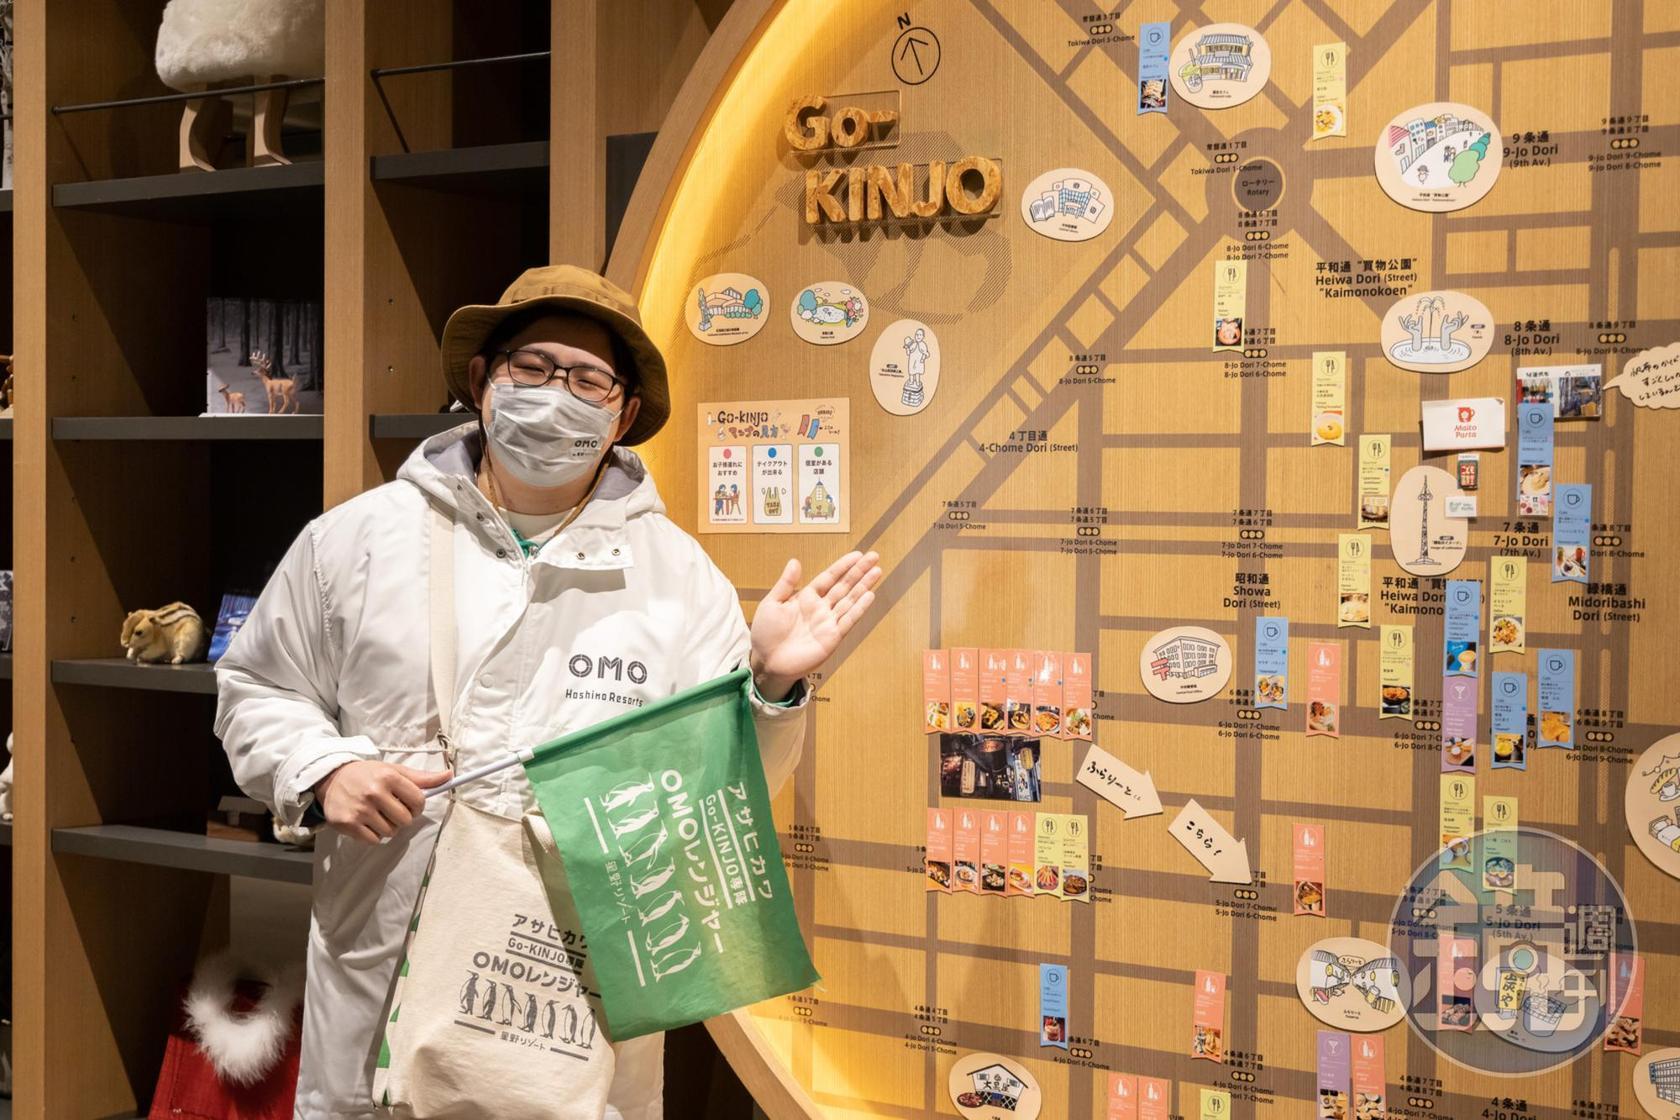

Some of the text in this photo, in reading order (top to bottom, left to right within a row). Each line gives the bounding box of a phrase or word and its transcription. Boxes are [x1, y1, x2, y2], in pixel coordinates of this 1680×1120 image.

[897, 12, 912, 30] N
[1068, 37, 1105, 47] Tokiwa Dori
[1502, 143, 1558, 158] 9-Jo Dori
[1509, 157, 1551, 168] (9th Av.)
[1588, 152, 1623, 163] 9-Jo Dori
[1233, 164, 1263, 172] 1-Chome
[1588, 162, 1623, 173] 9-Jo Dori
[1242, 179, 1275, 187] ロータリー
[805, 156, 1002, 224] KINJO
[1247, 188, 1269, 197] Rotary
[1226, 242, 1289, 252] 8-Jo Dori 6-Chome
[1226, 254, 1240, 262] 8-Jo
[1315, 261, 1351, 274] 平和通
[1315, 272, 1418, 286] Heiwa Dori (Street)
[1504, 333, 1560, 347] 8-Jo Dori
[1511, 346, 1552, 357] (8th Av.)
[1576, 347, 1592, 357] 8-Jo
[1594, 346, 1610, 355] Dori
[1224, 360, 1287, 370] 8-Jo Dori 7-Chome
[1224, 369, 1287, 379] 8-Jo Dori 6-Chome
[1058, 376, 1117, 386] 8-Jo Dori 5-Chome
[717, 410, 769, 427] Go-KINJO
[728, 424, 779, 440] マップの見方
[1009, 430, 1048, 442] 4丁目通
[574, 439, 598, 449] OMO
[979, 441, 1079, 453] 4-Chome Dori (Street)
[757, 460, 788, 468] テイクアウト
[717, 469, 738, 477] おすすめ
[762, 469, 783, 477] が出来る
[933, 522, 987, 530] 7-Jo Dori 5-Chome
[1503, 521, 1540, 534] 7条通
[1060, 538, 1118, 547] 7-Jo Dori 6-Chome
[1221, 541, 1283, 551] 7-Jo Dori 7-Chome
[1494, 535, 1549, 548] 7-Jo Dori
[1060, 547, 1118, 556] 7-Jo Dori 5-Chome
[1221, 551, 1283, 560] 7-Jo Dori 6-Chome
[1500, 548, 1541, 559] (7th Av.)
[1235, 572, 1270, 585] 昭和通
[1382, 576, 1419, 589] 平和通
[1233, 585, 1271, 597] Showa
[1586, 582, 1627, 596] 緑橋通
[1380, 590, 1418, 602] Heiwa
[1223, 597, 1281, 610] Dori (Street)
[1568, 595, 1646, 609] Midoribashi
[1384, 602, 1445, 615] "Kaimono
[1573, 609, 1640, 623] Dori (Street)
[568, 653, 648, 684] OMO
[565, 688, 644, 707] Hoshino Resorts
[1218, 721, 1280, 731] 6-Jo Dori 7-Chome
[1218, 730, 1280, 741] 6-Jo Dori 6-Chome
[1394, 731, 1426, 742] 6-Jo Dori
[1394, 741, 1426, 751] 6-Jo Dori
[1582, 744, 1598, 752] Dori
[1566, 753, 1598, 762] 6-Jo Dori
[727, 781, 774, 900] アサヒカワ
[660, 768, 724, 954] OMOレンジャー
[604, 860, 633, 924] 星野リゾート
[1216, 899, 1278, 912] 5-Jo Dori 7-Chome
[1216, 908, 1278, 922] 5-Jo Dori 6-Chome
[1486, 915, 1541, 931] 5-Jo Dori
[472, 951, 603, 1000] OMOレンジャー
[500, 1031, 547, 1052] 星野リゾート
[918, 1034, 930, 1043] Dori
[918, 1043, 930, 1052] Dori
[1067, 1057, 1081, 1066] Dori
[1212, 1080, 1242, 1091] 4-Jo Dori
[1490, 1096, 1528, 1112] 4条通
[1387, 1105, 1420, 1118] 4-Jo Dori
